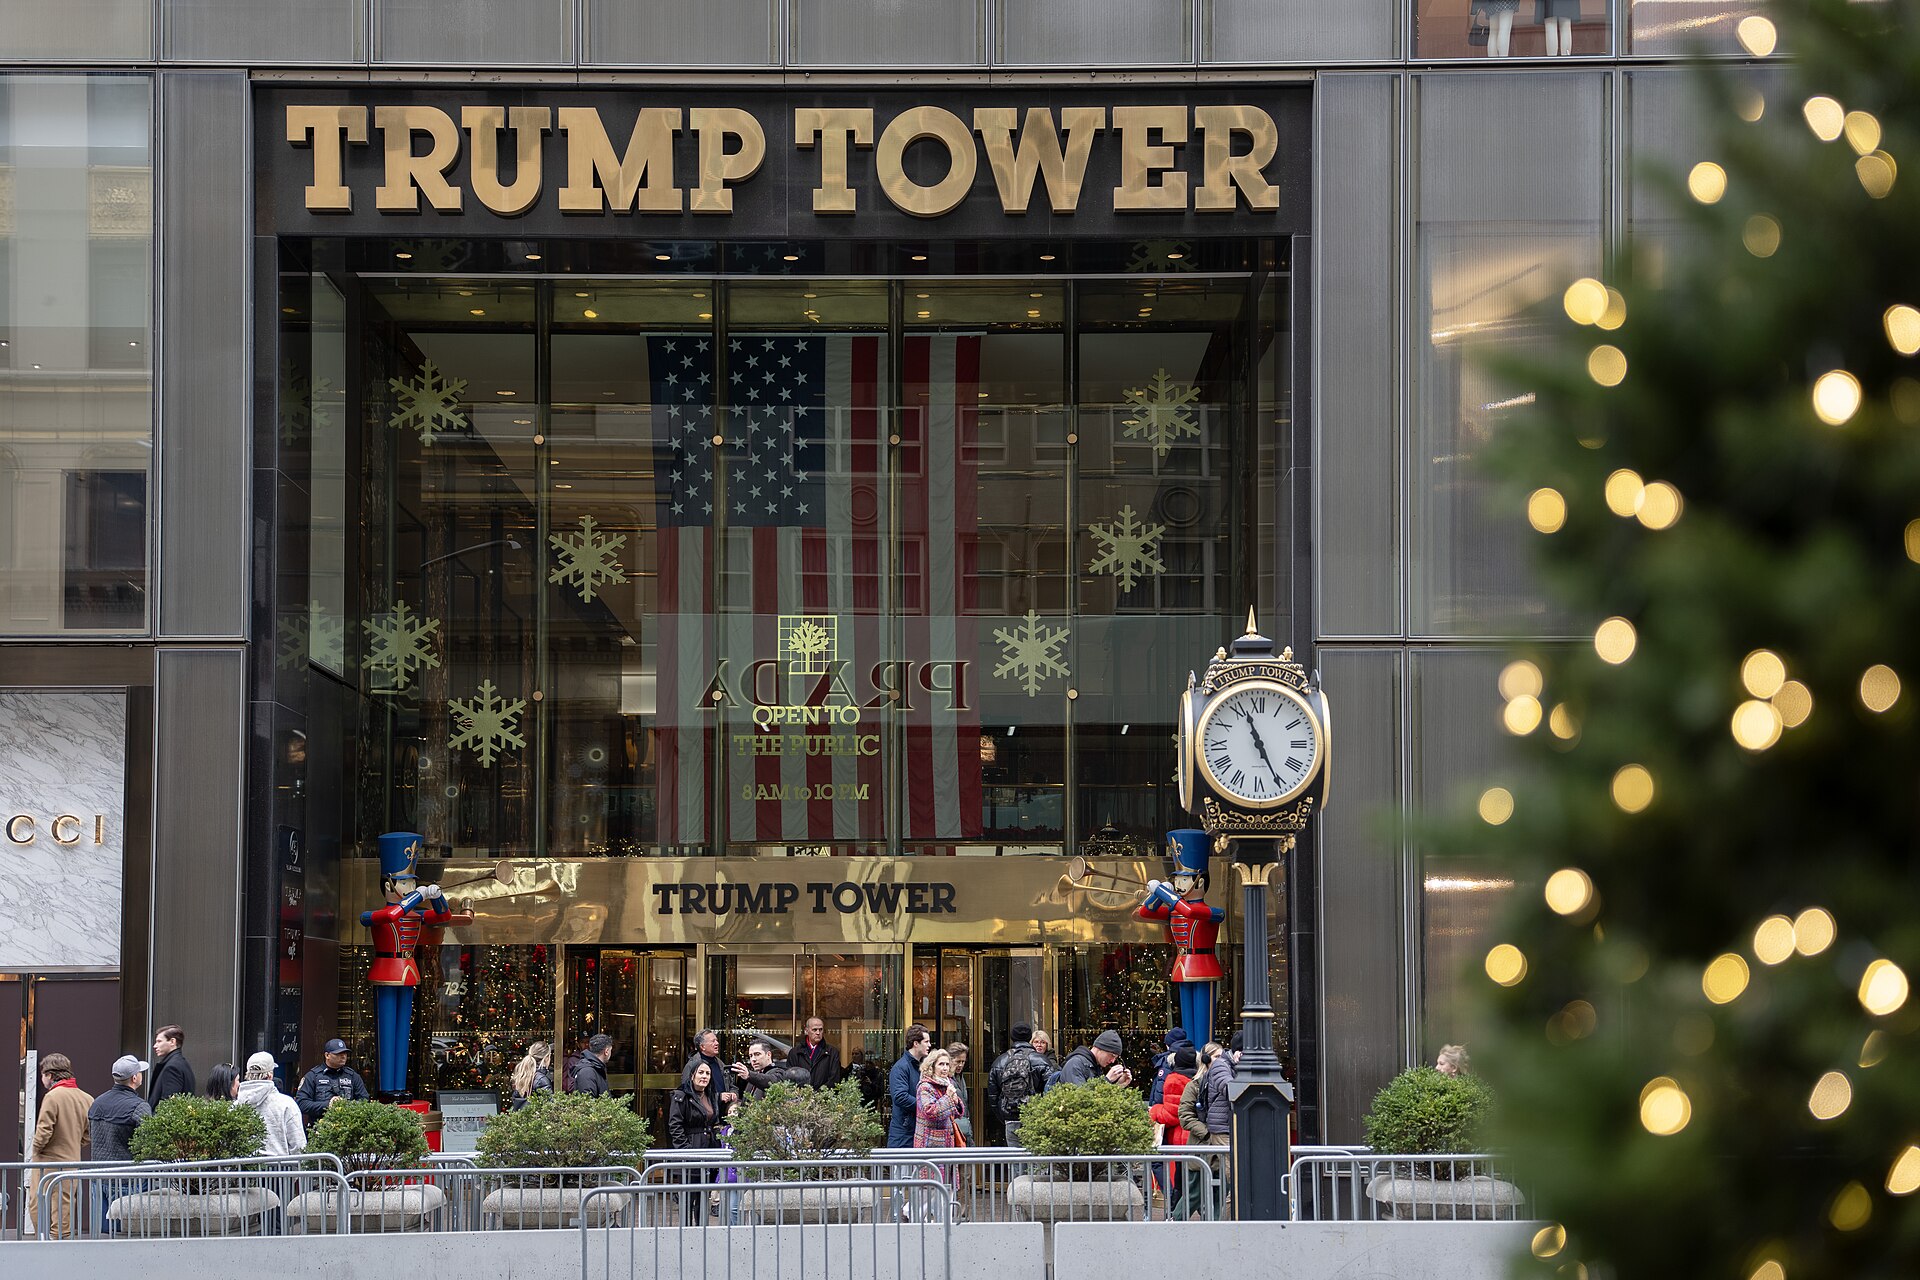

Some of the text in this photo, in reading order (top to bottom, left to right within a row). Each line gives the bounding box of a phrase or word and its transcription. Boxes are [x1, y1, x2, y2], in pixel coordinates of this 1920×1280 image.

[286, 105, 1280, 217] TRUMP TOWER
[1216, 666, 1298, 685] TRUMP TOWER
[752, 705, 861, 726] OPEN TO
[733, 735, 880, 756] THE PUBLIC
[742, 784, 870, 800] 8 AM to 10 PM
[652, 881, 957, 915] TRUMP TOWER
[443, 981, 469, 996] 725
[1139, 980, 1166, 994] 725
